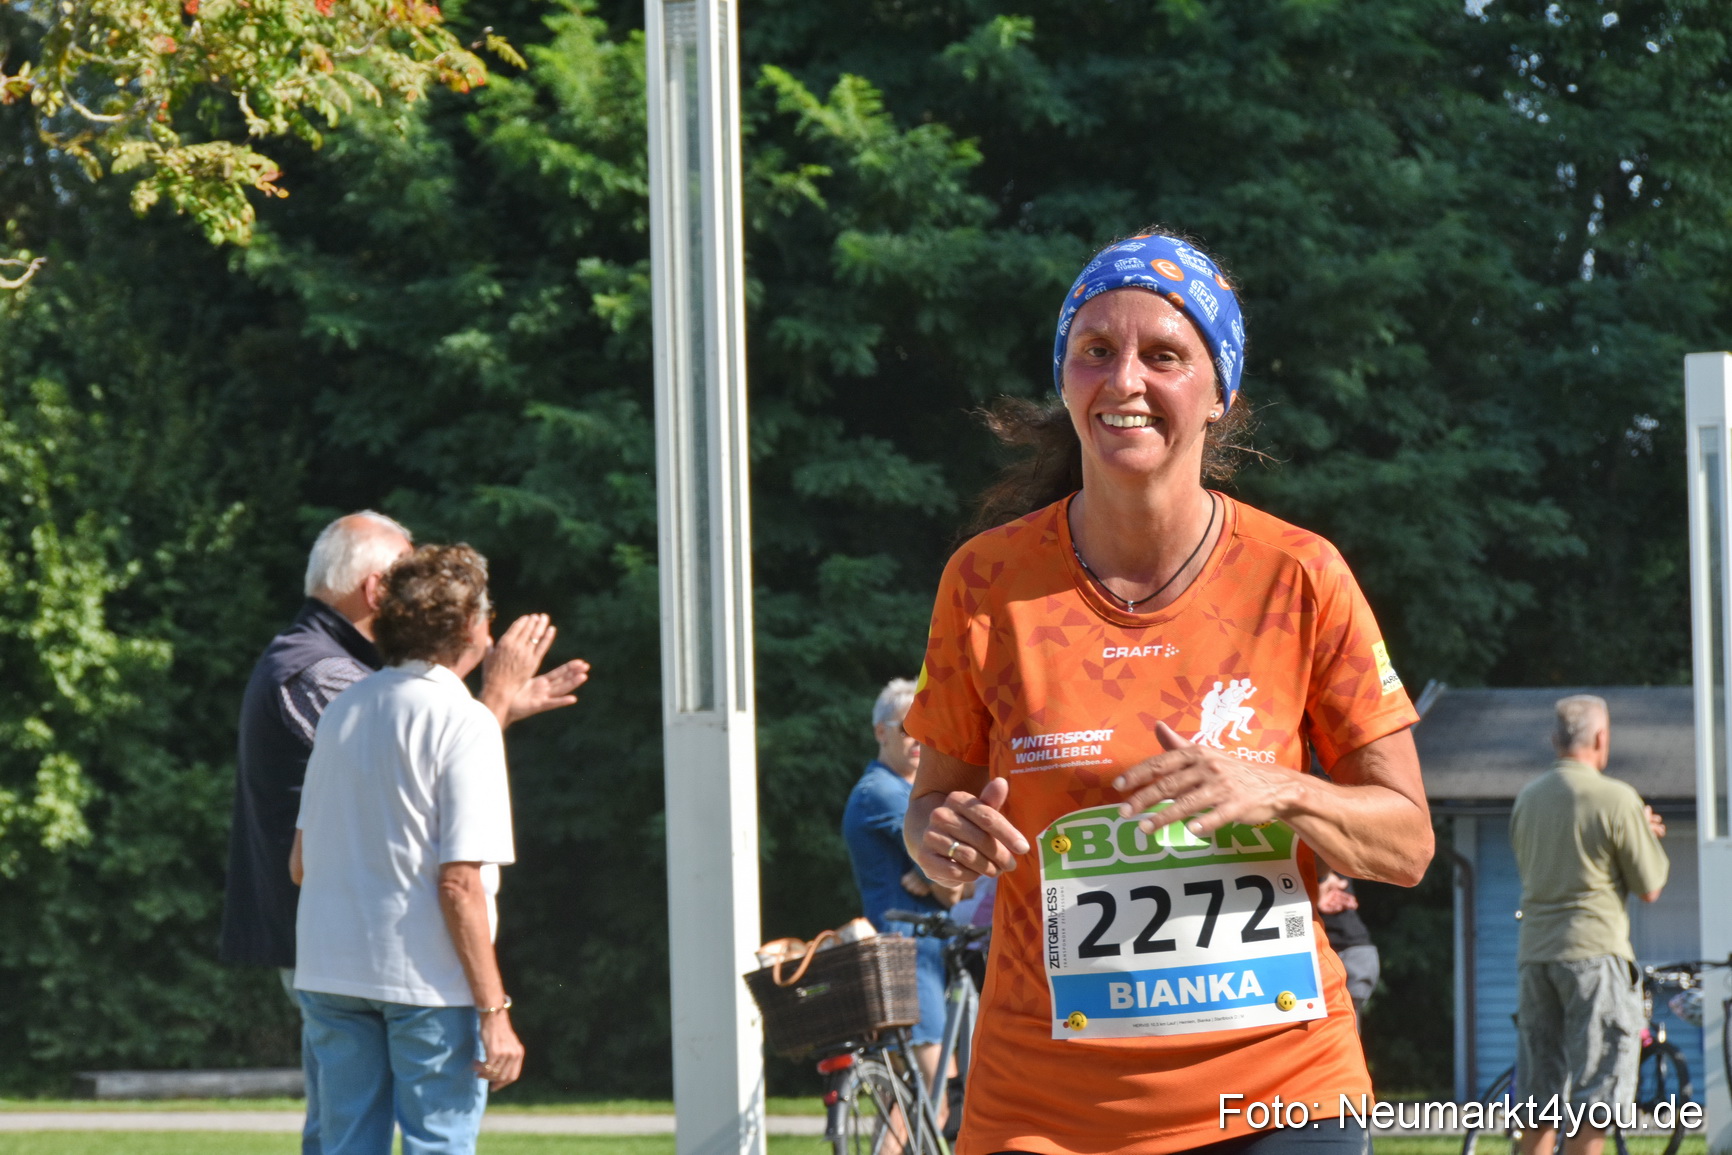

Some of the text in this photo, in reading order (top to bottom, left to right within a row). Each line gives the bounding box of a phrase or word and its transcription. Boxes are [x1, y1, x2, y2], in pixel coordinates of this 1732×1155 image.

[1191, 280, 1219, 317] GIPFEL
[1102, 645, 1163, 658] CRAFT
[1023, 729, 1114, 749] INTERSPORT
[1016, 745, 1102, 764] WOHLLEBEN
[1281, 878, 1294, 890] D
[1076, 874, 1281, 959] 2272
[1108, 969, 1265, 1011] BIANKA
